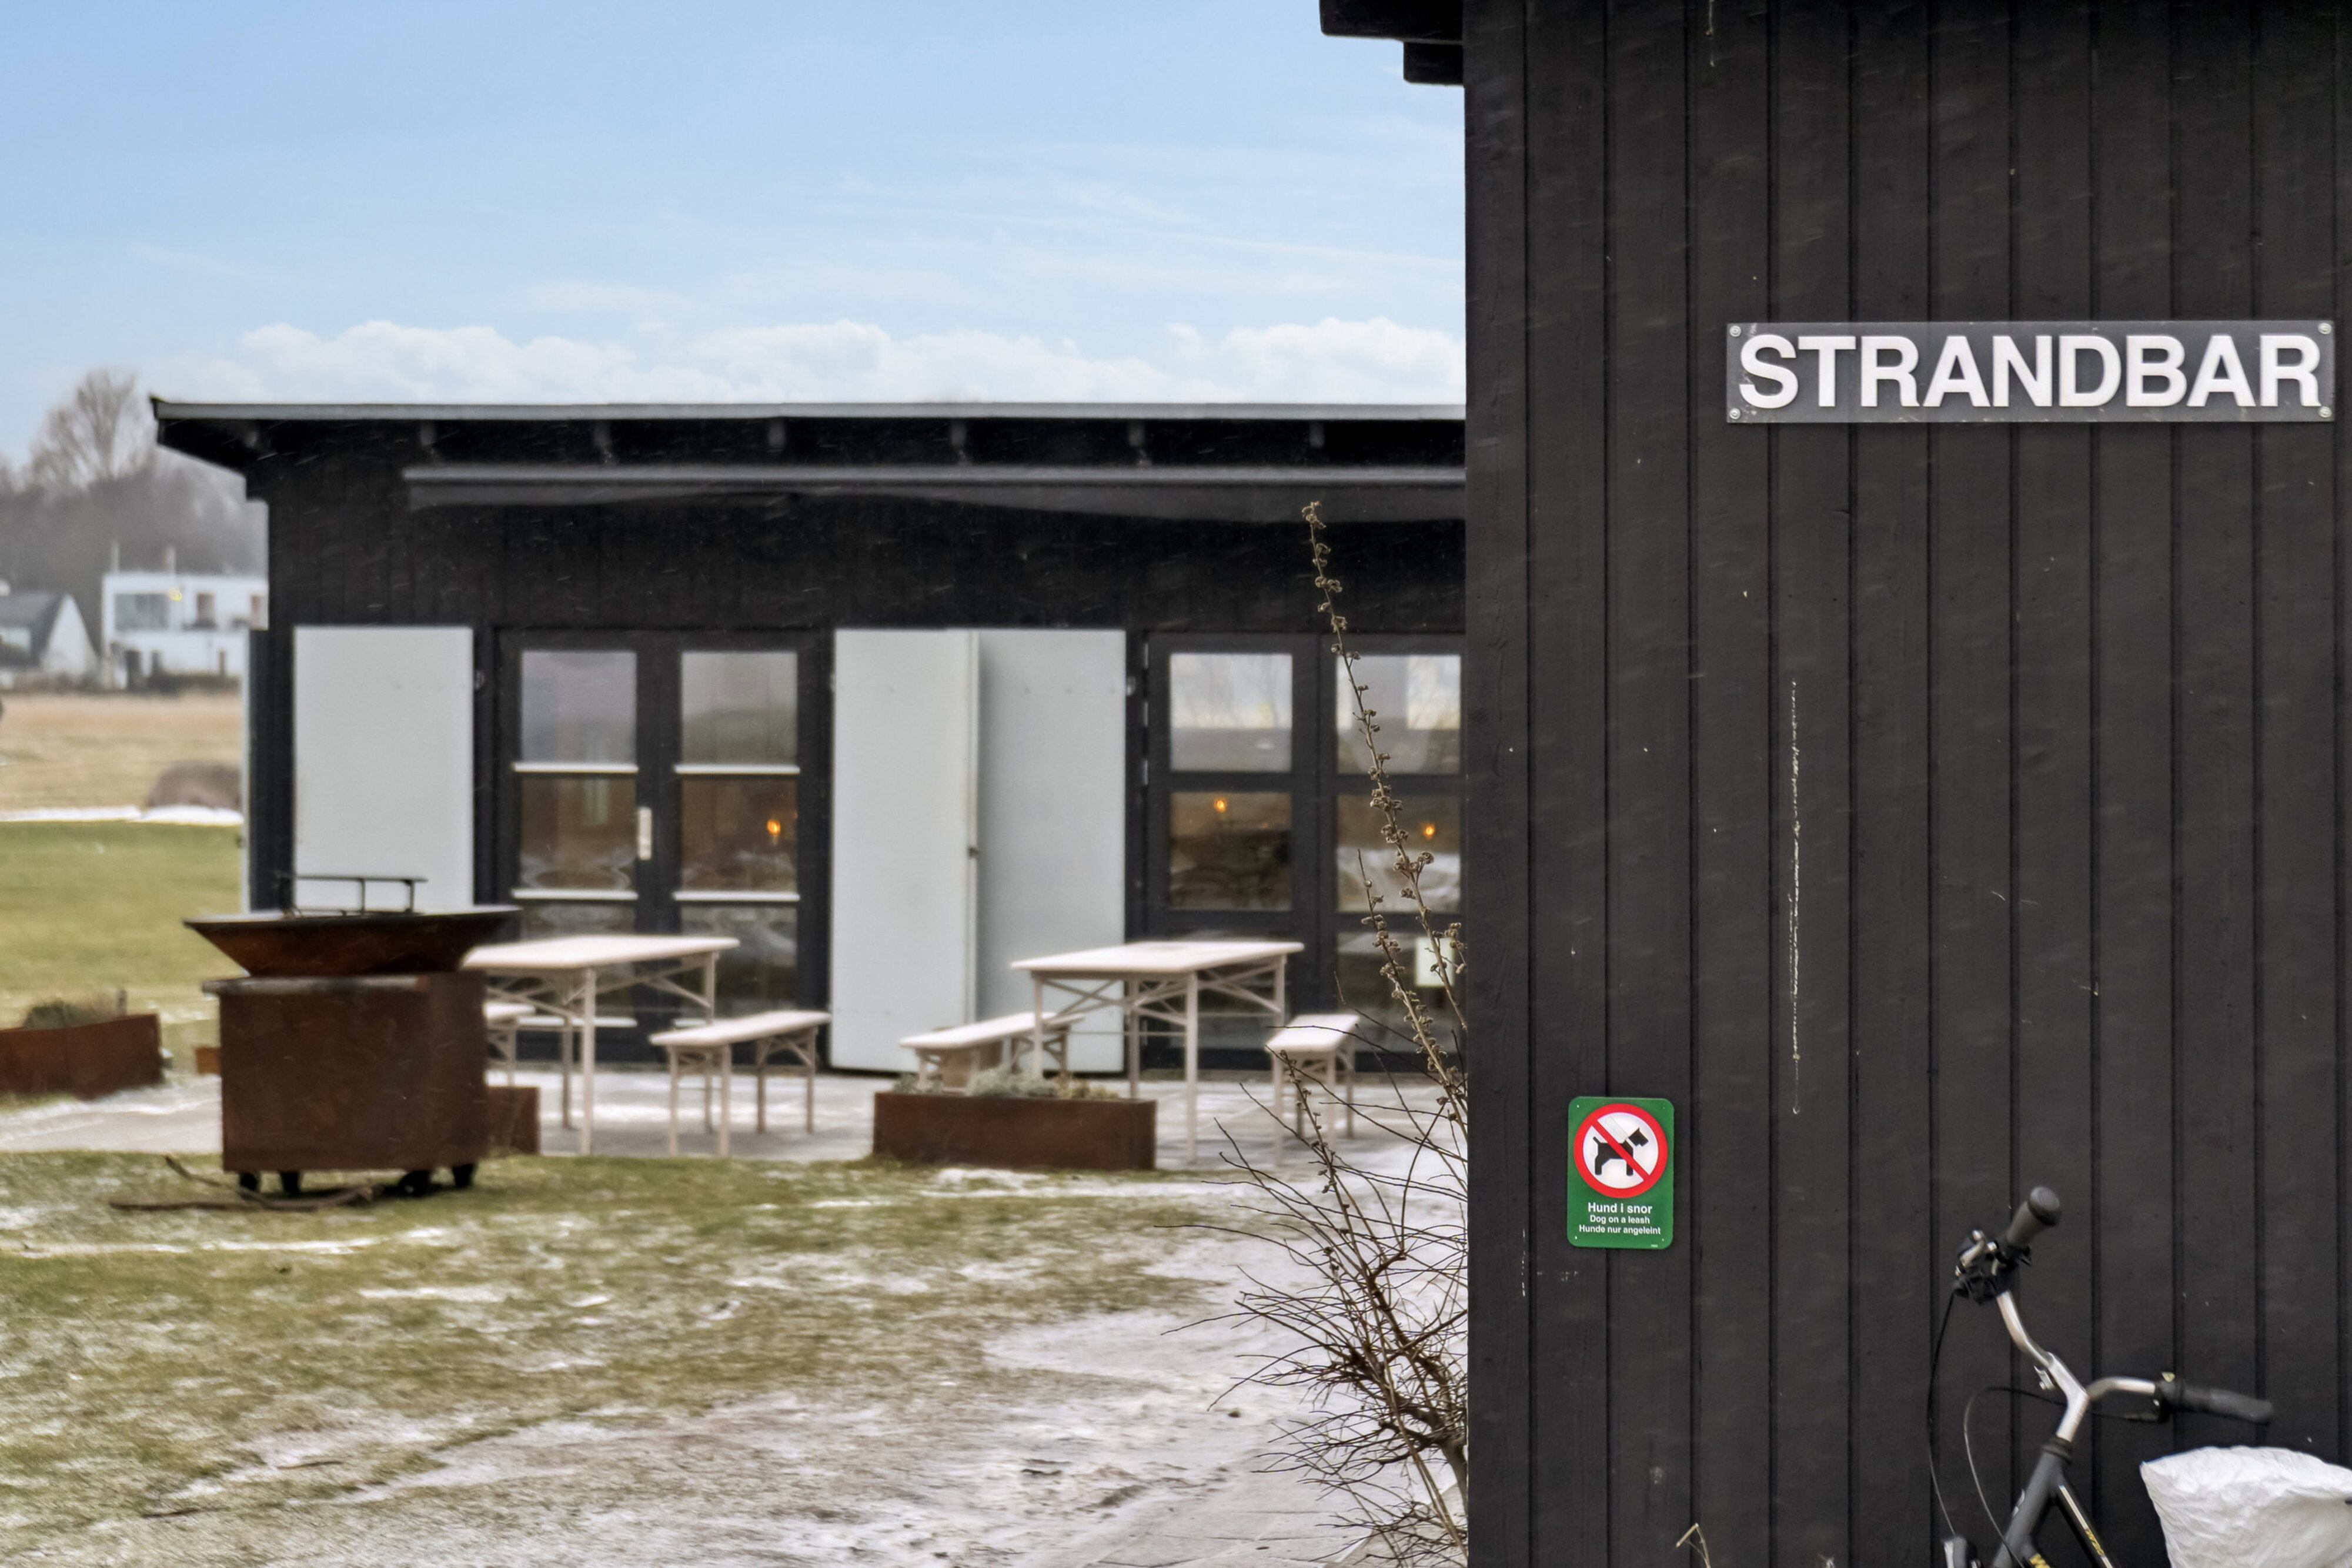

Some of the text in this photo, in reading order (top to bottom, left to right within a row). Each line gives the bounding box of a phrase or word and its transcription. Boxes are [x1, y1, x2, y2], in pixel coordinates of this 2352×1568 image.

[1739, 334, 2322, 409] STRANDBAR
[1588, 1202, 1653, 1214] Hund i snor
[1589, 1214, 1606, 1225] Dog
[1628, 1216, 1651, 1224] leash
[1579, 1224, 1605, 1233] Hunde
[1623, 1226, 1661, 1235] angeleint
